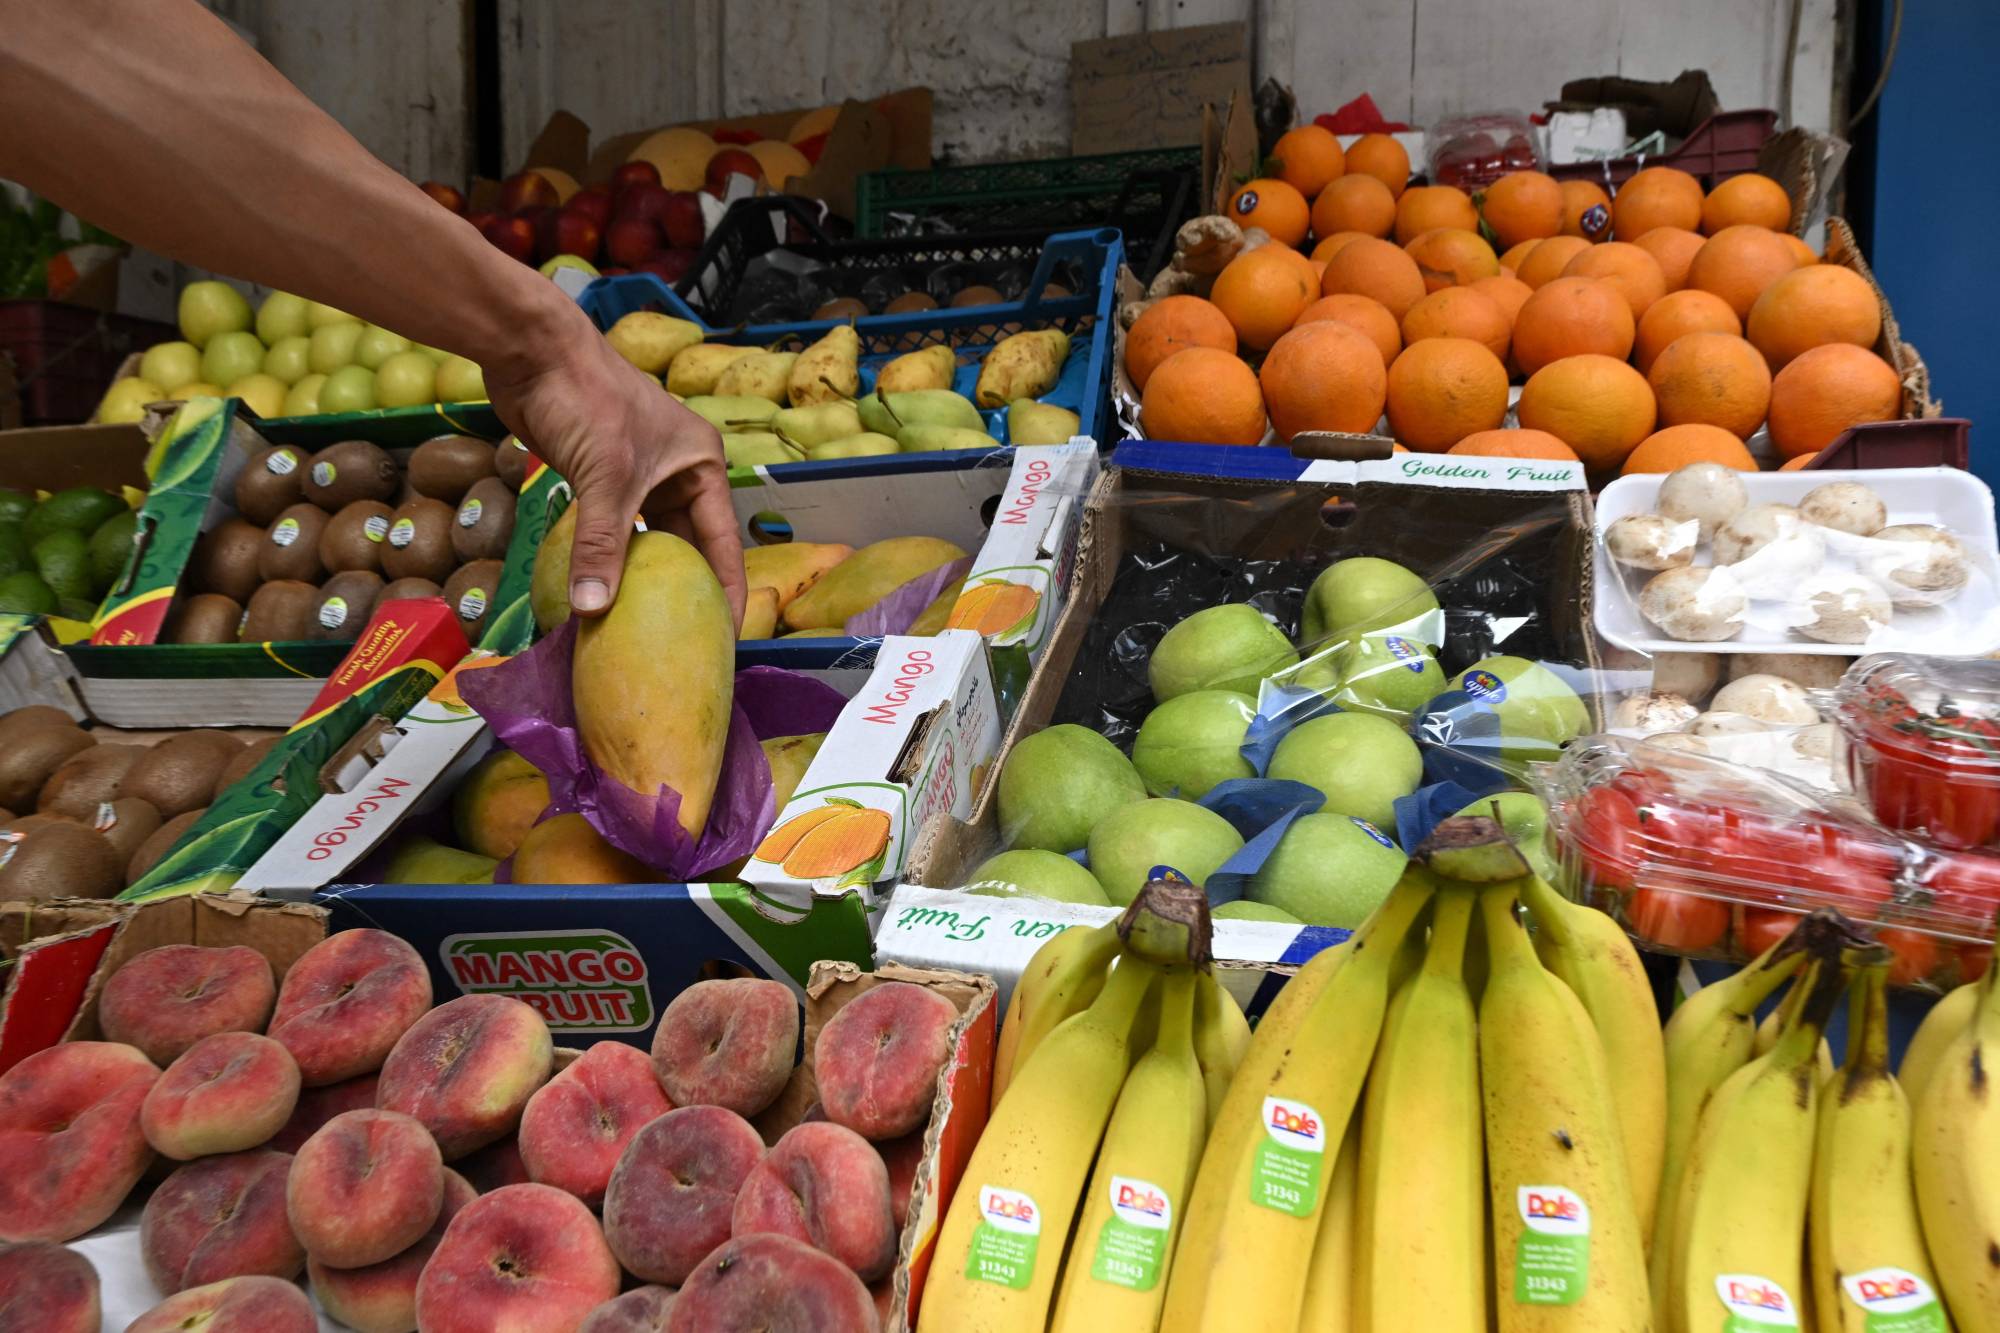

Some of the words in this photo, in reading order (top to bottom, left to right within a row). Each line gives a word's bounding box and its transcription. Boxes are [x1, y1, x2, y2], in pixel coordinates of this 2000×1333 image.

[1402, 459, 1490, 479] Golden
[1507, 466, 1574, 481] Fruit
[1000, 460, 1051, 525] Mango
[862, 650, 935, 725] Mango
[1465, 680, 1502, 700] apple
[306, 777, 412, 861] Mango
[897, 906, 992, 941] Fruit
[450, 950, 645, 985] MANGO
[506, 992, 628, 1022] RUIT
[1272, 1105, 1318, 1135] Dole
[1118, 1184, 1165, 1212] Dole
[1264, 1182, 1300, 1204] 31343
[1528, 1193, 1580, 1219] Dole
[988, 1194, 1033, 1220] Dole
[979, 1260, 1016, 1279] 31343
[1729, 1282, 1785, 1309] Dole
[1858, 1277, 1916, 1299] Dole
